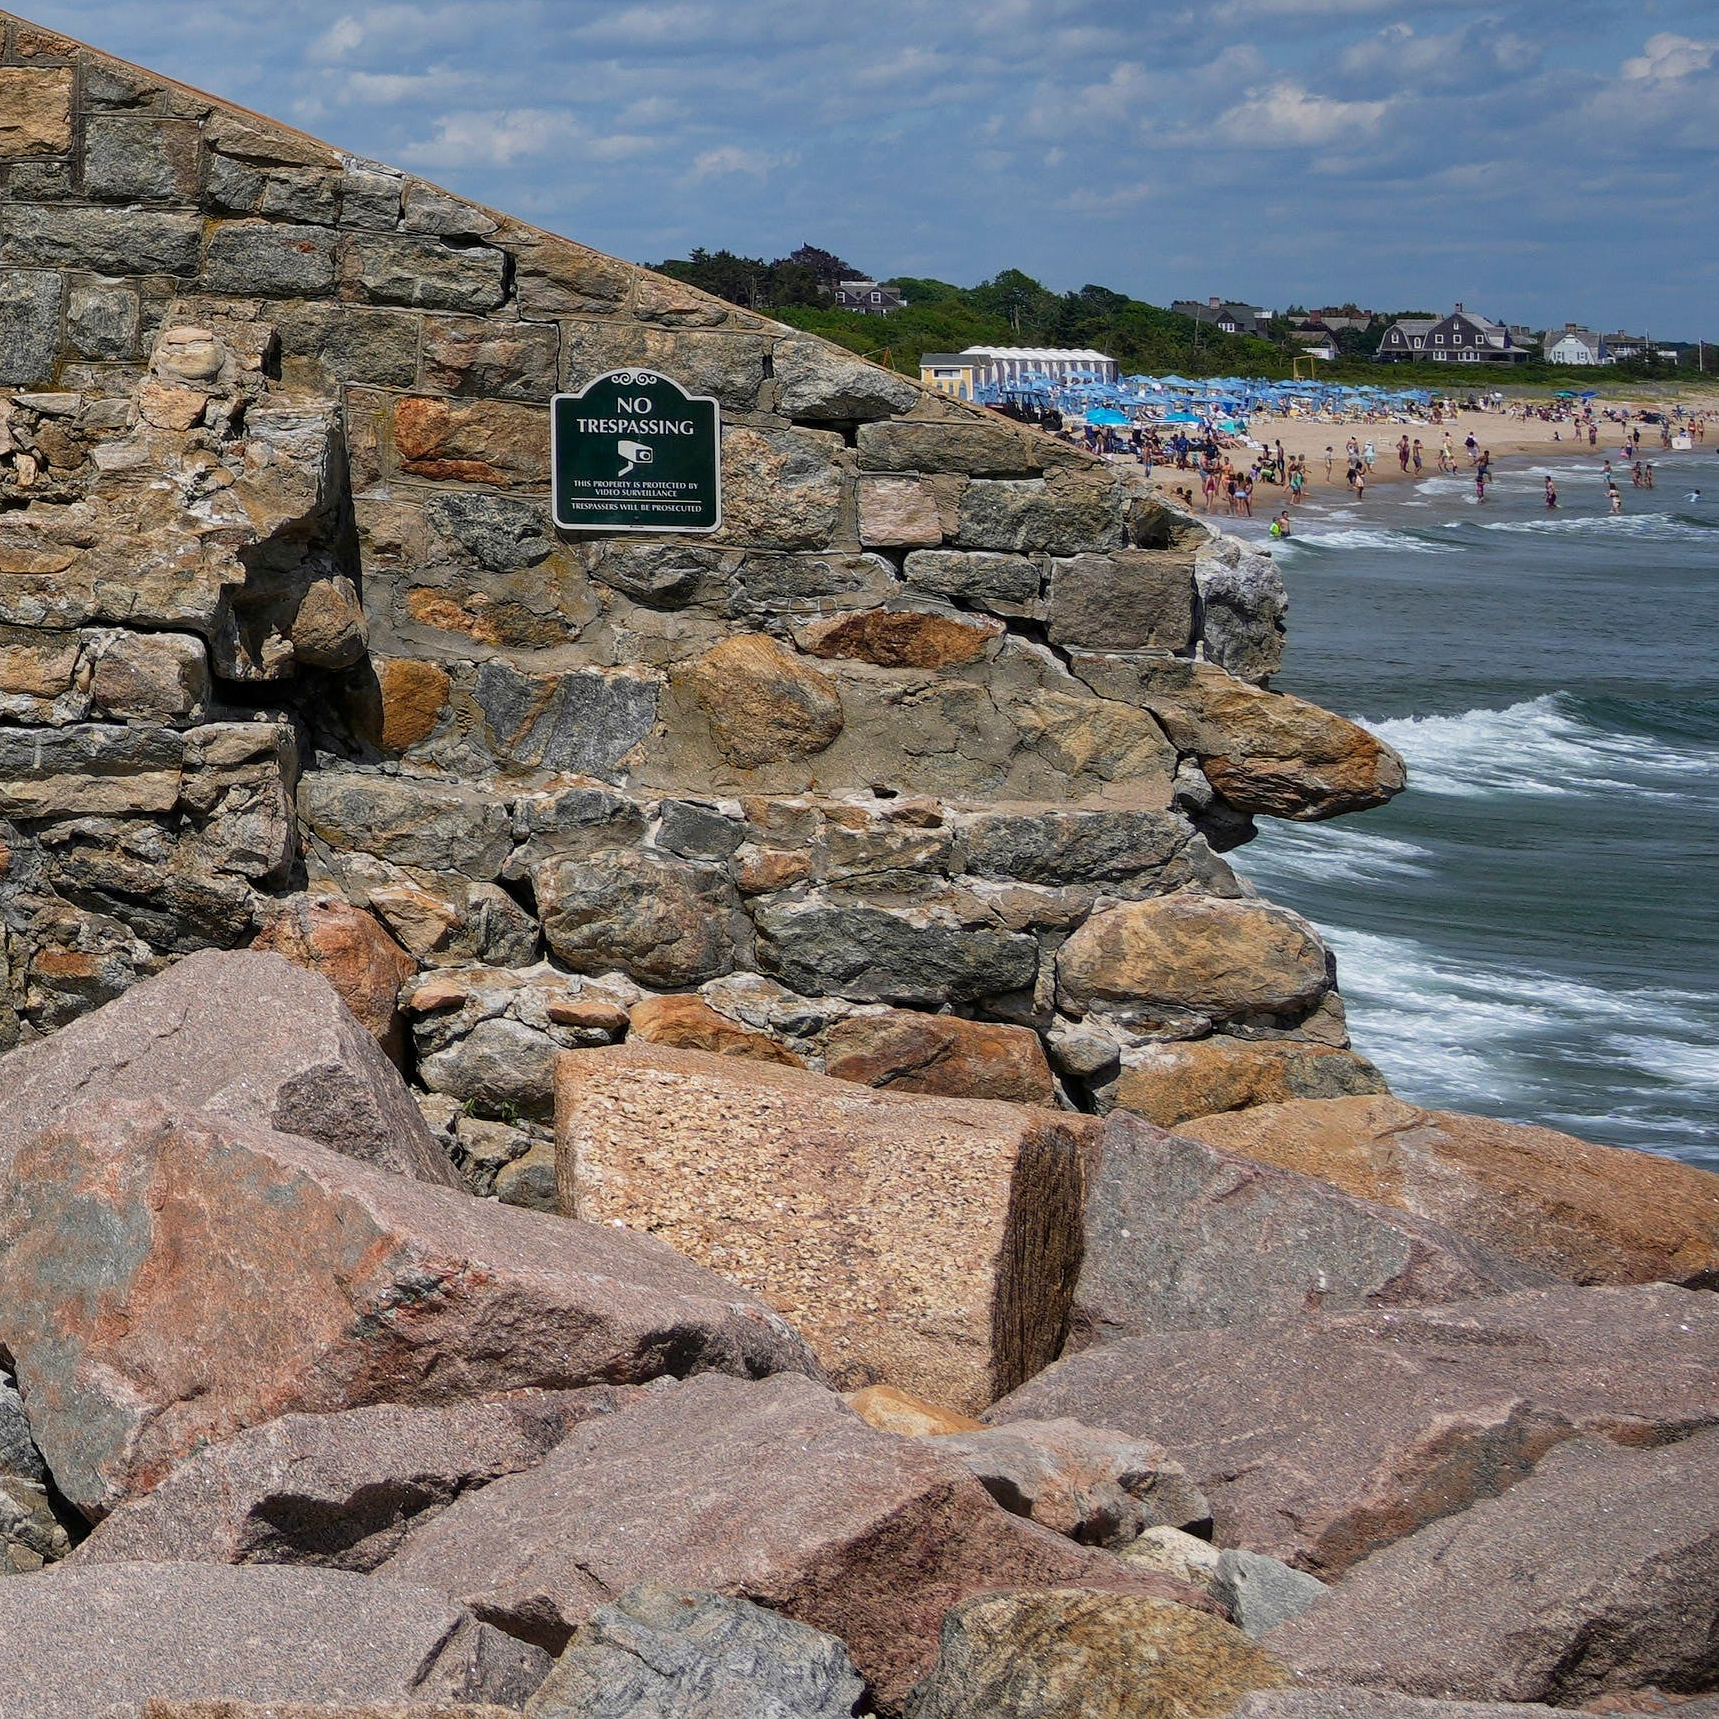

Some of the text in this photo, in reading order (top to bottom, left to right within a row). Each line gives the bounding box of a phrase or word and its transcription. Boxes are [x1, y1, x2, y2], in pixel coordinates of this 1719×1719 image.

[617, 397, 652, 414] NO
[577, 419, 694, 435] TRESPASSING
[622, 489, 677, 497] SURVEILLANCE
